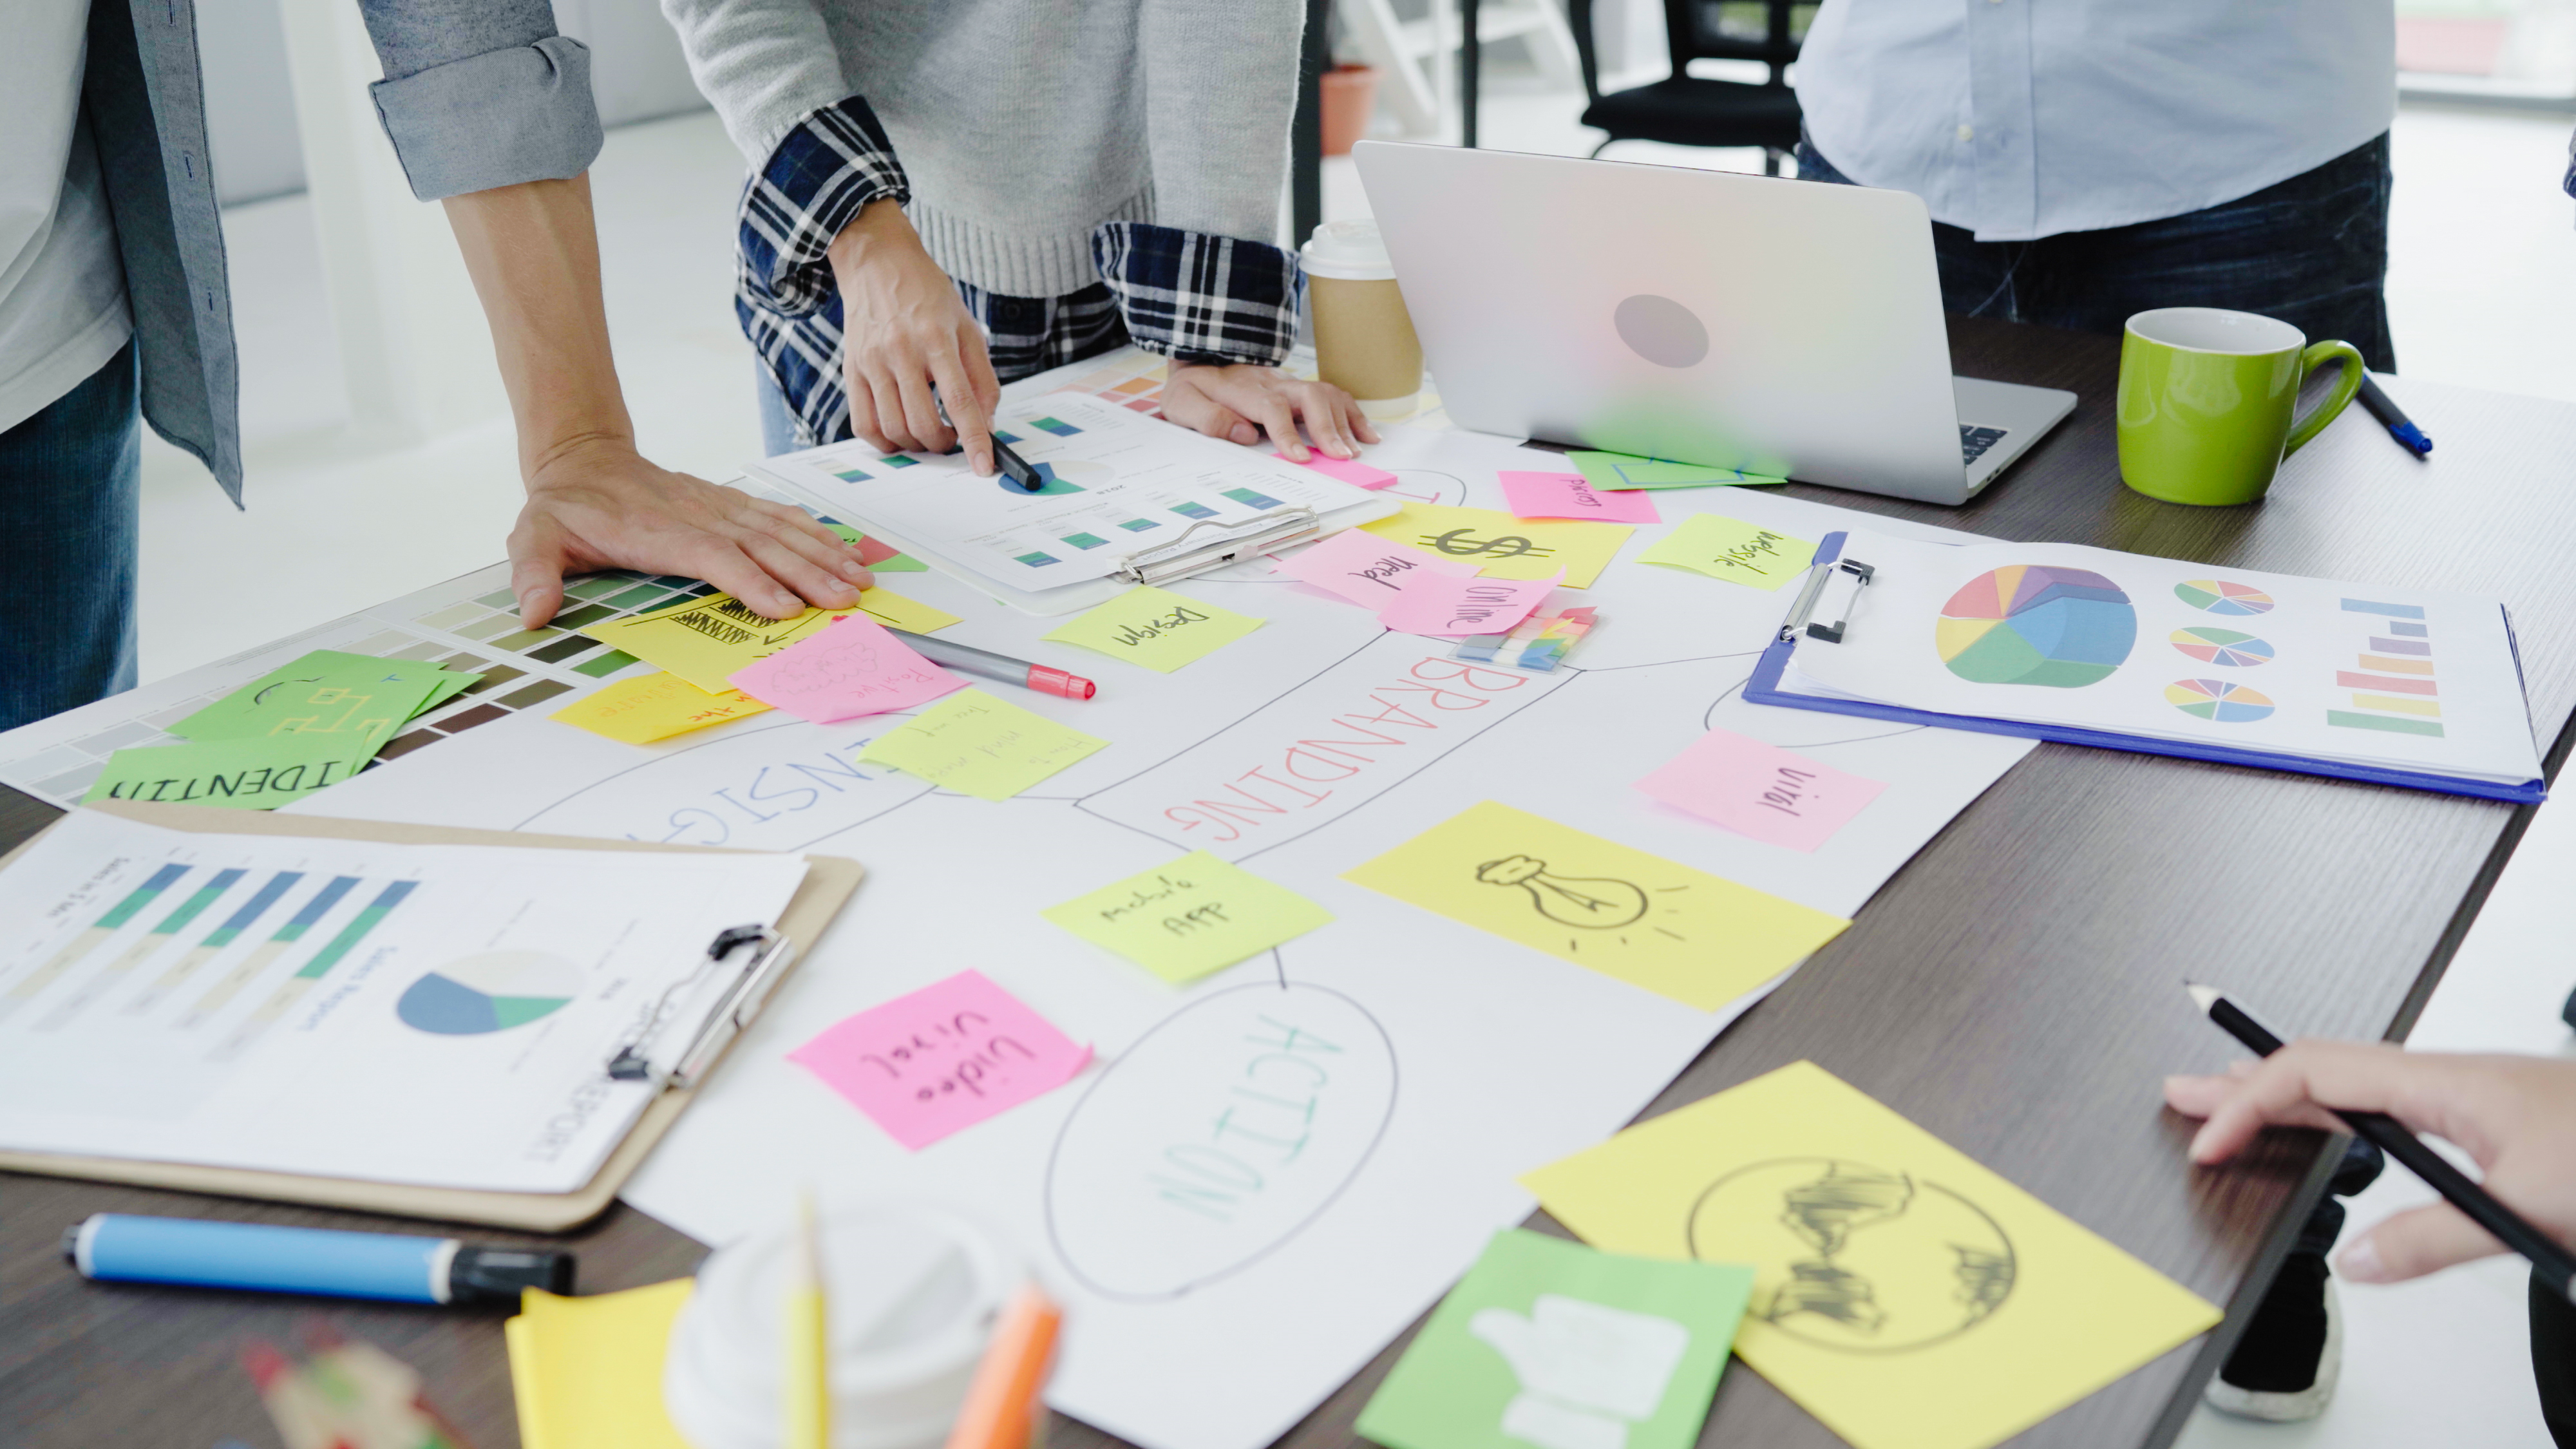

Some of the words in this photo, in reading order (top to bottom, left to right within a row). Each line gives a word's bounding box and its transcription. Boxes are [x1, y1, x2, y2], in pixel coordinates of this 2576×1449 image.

[1095, 484, 1127, 496] 2018
[1141, 546, 1174, 562] Report
[1111, 605, 1210, 647] Design
[1162, 656, 1530, 842] BRANDING
[1144, 1012, 1346, 1224] ACTION
